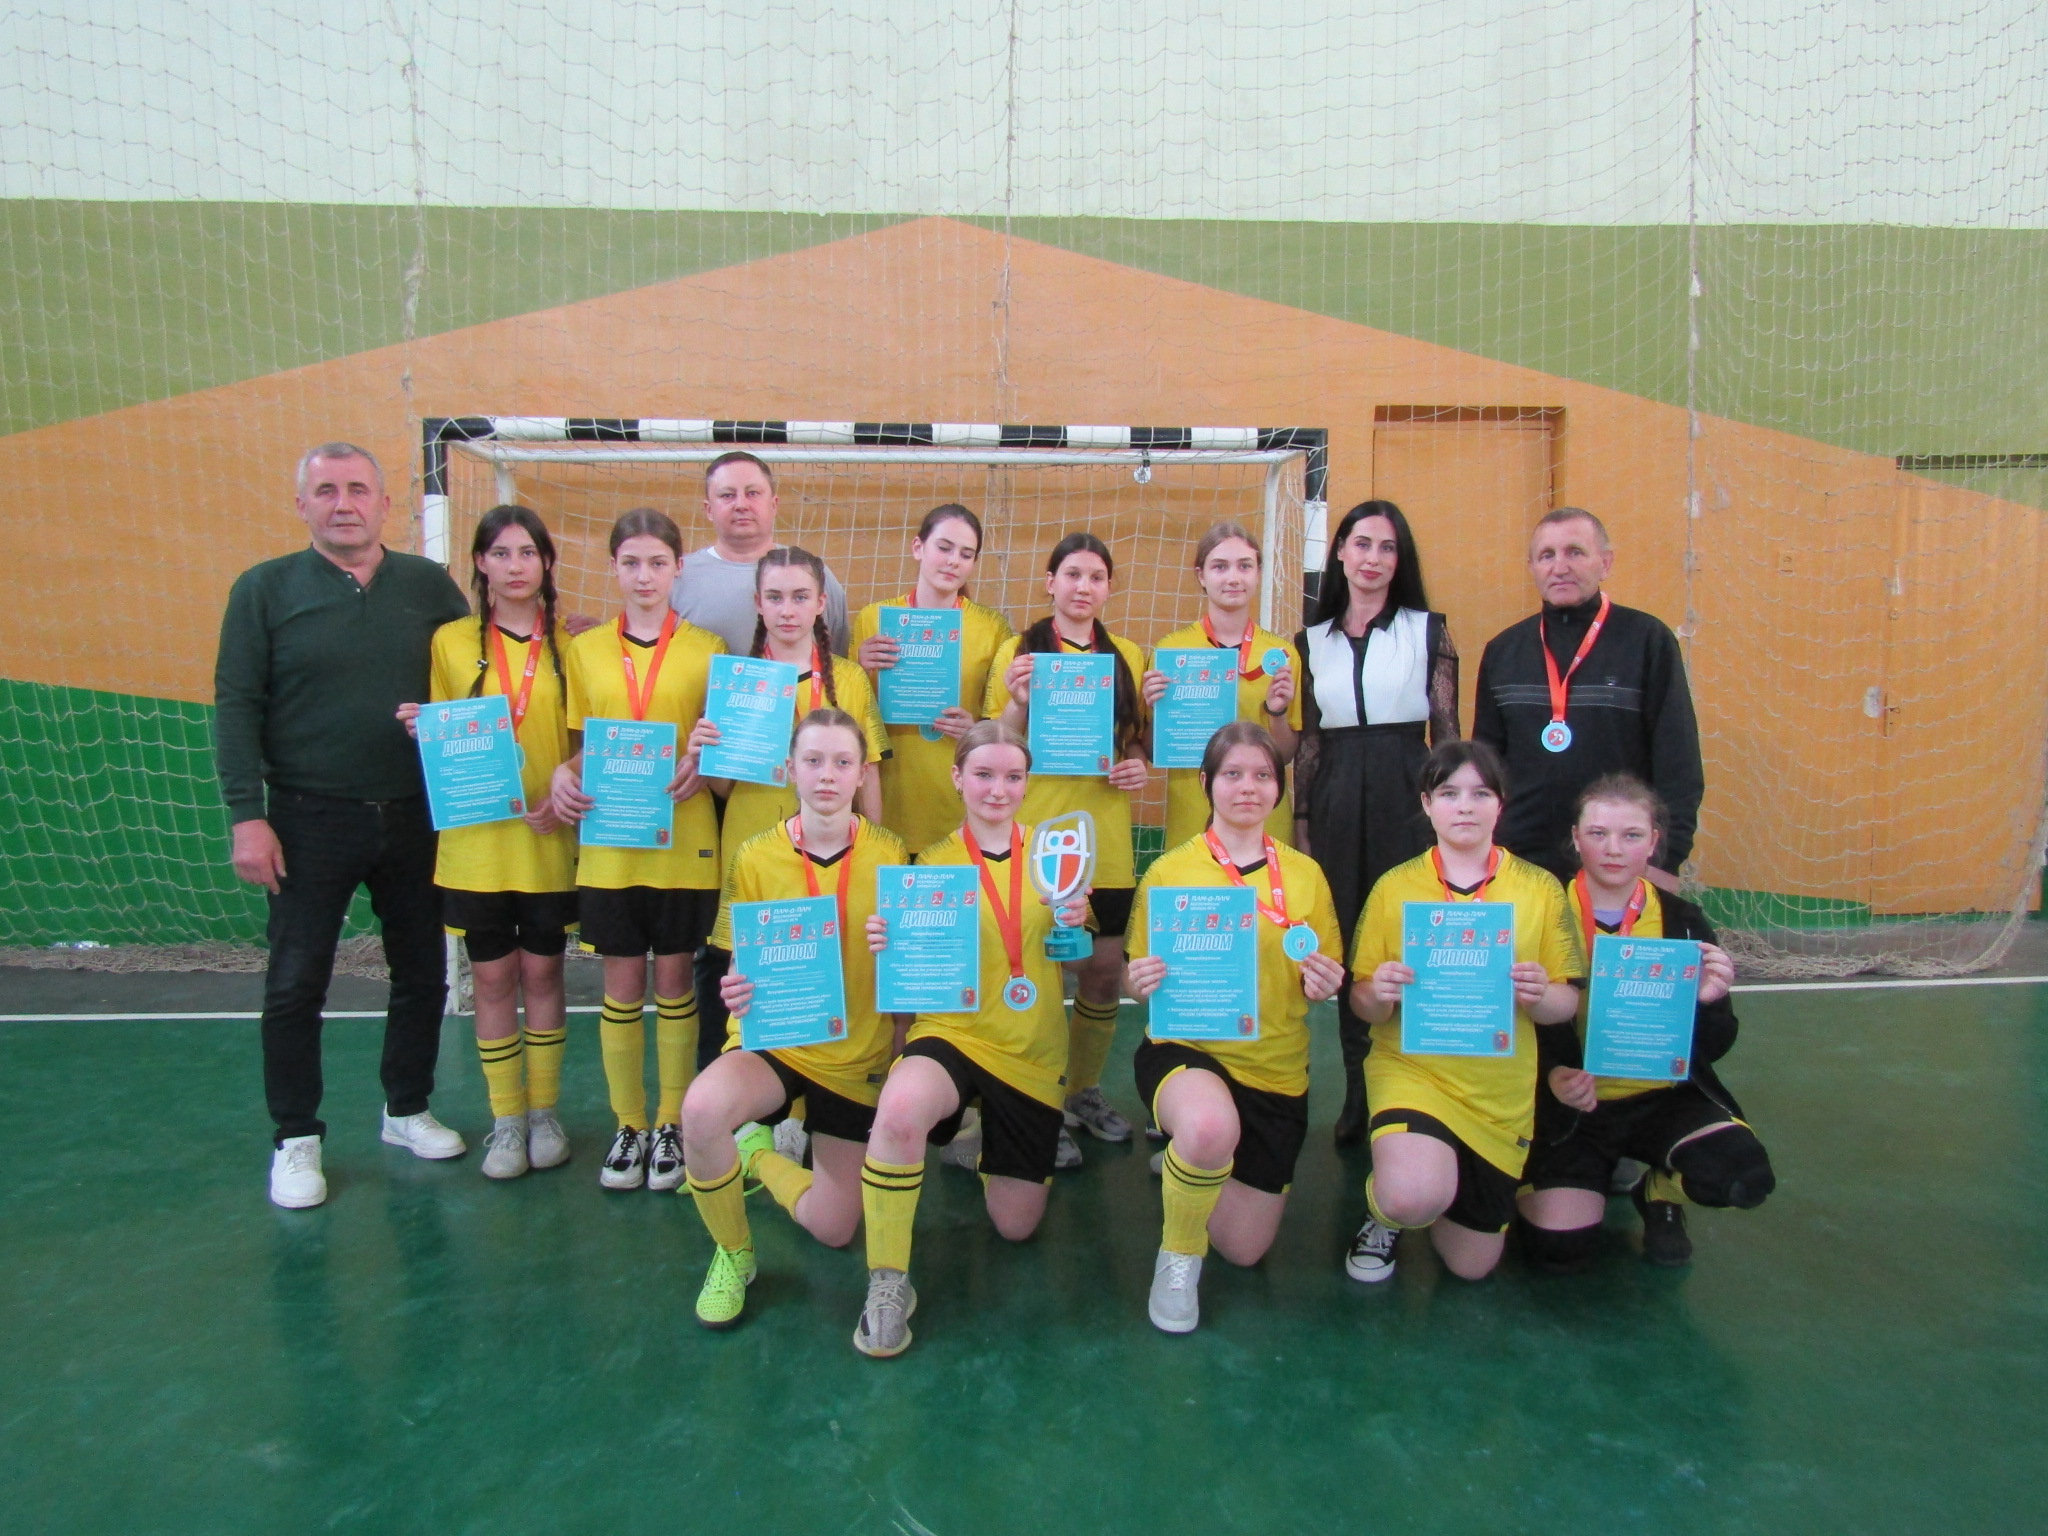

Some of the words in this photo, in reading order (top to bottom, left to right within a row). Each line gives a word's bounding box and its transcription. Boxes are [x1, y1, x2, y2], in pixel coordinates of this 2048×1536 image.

[897, 644, 943, 658] ДИПЛОМ
[1049, 691, 1095, 705] ДИПЛОМ
[1173, 685, 1219, 700] ДИПЛОМ
[726, 693, 776, 712] ДИПЛОМ
[443, 736, 493, 757] ДИПЛОМ
[603, 759, 654, 775] ДИПЛОМ
[900, 910, 957, 928] ДИПЛОМ
[1173, 934, 1233, 952] ДИПЛОМ
[760, 942, 816, 965] ДИПЛОМ
[1428, 949, 1489, 967] ДИПЛОМ
[1614, 980, 1674, 998] ДИПЛОМ
